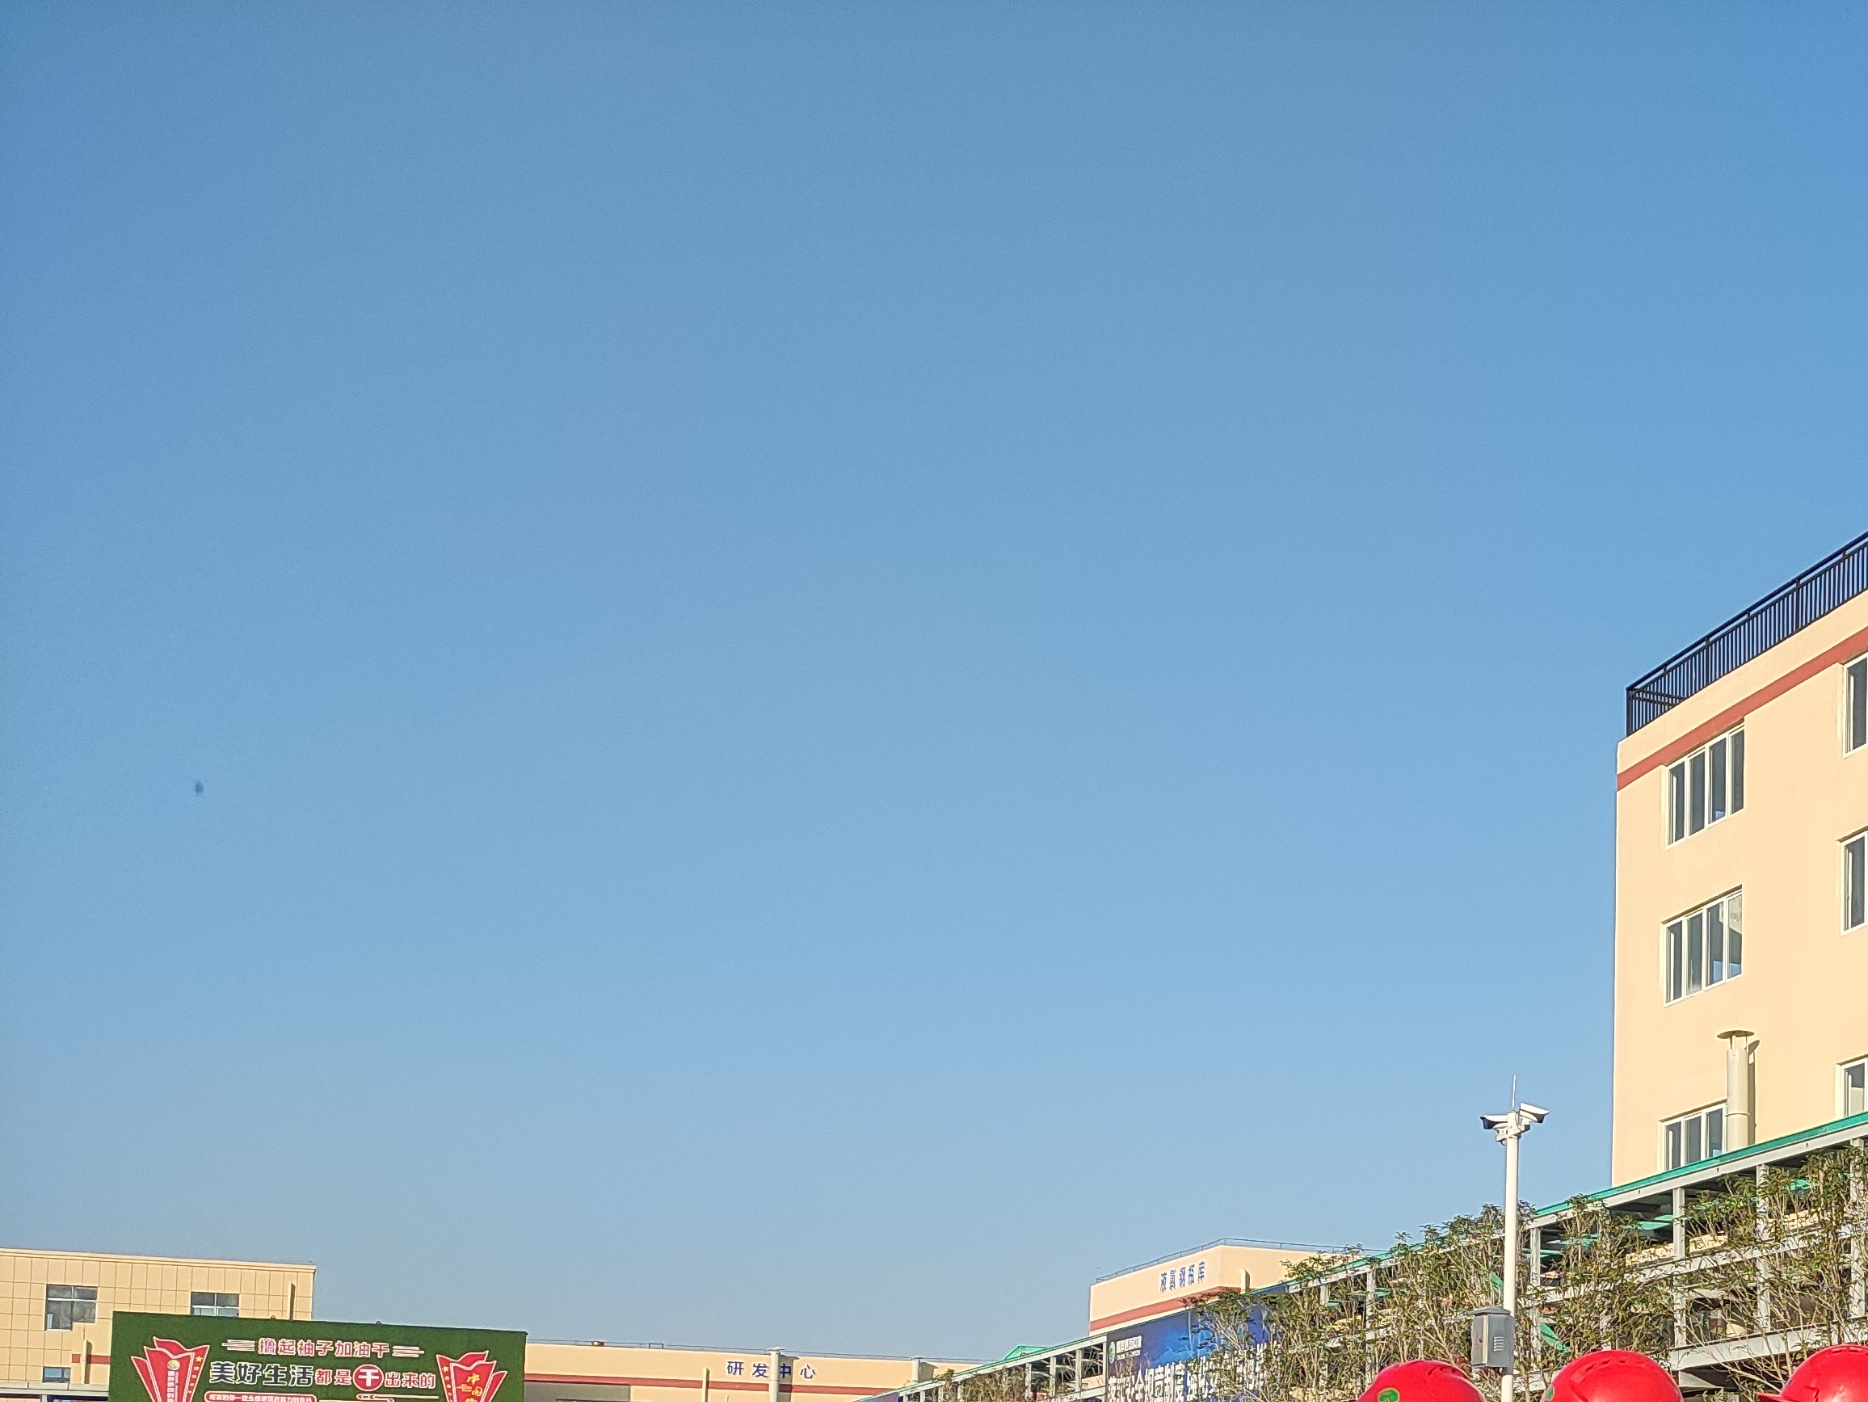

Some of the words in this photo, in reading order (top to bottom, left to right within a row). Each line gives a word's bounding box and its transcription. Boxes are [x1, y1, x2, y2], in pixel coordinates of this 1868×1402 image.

[258, 1338, 390, 1359] 撸起袖子加油干
[726, 1360, 817, 1380] 研发中心
